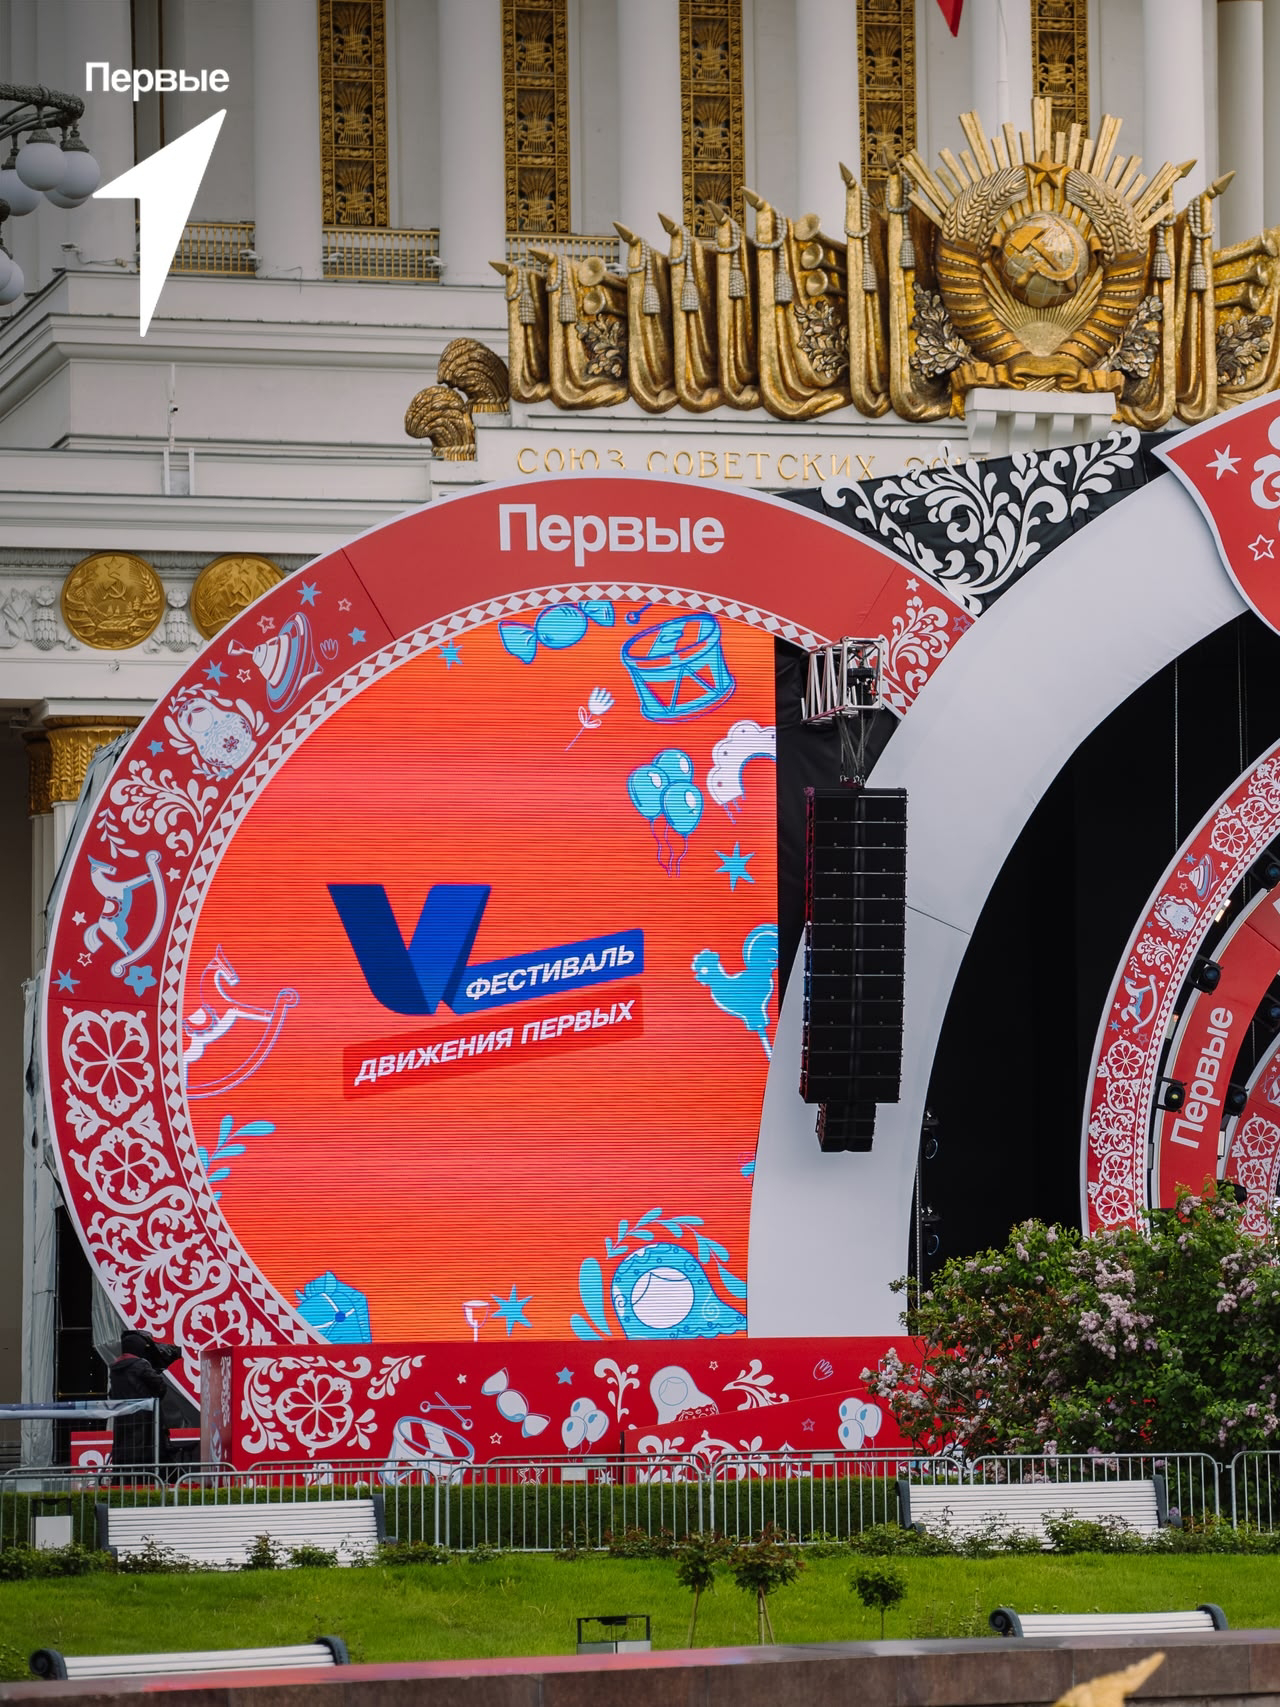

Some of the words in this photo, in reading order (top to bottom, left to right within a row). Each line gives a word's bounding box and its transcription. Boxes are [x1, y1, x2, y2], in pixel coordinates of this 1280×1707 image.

[516, 447, 627, 474] СОЮЗ
[646, 450, 876, 481] СОВЕТСКИХ
[499, 503, 725, 567] Первые
[465, 944, 636, 1001] ФЕСТИВАЛЬ
[353, 1027, 514, 1087] ДВИЖЕНИЯ
[520, 1000, 636, 1045] ПЕРВЫХ
[1170, 1006, 1234, 1149] Первые
